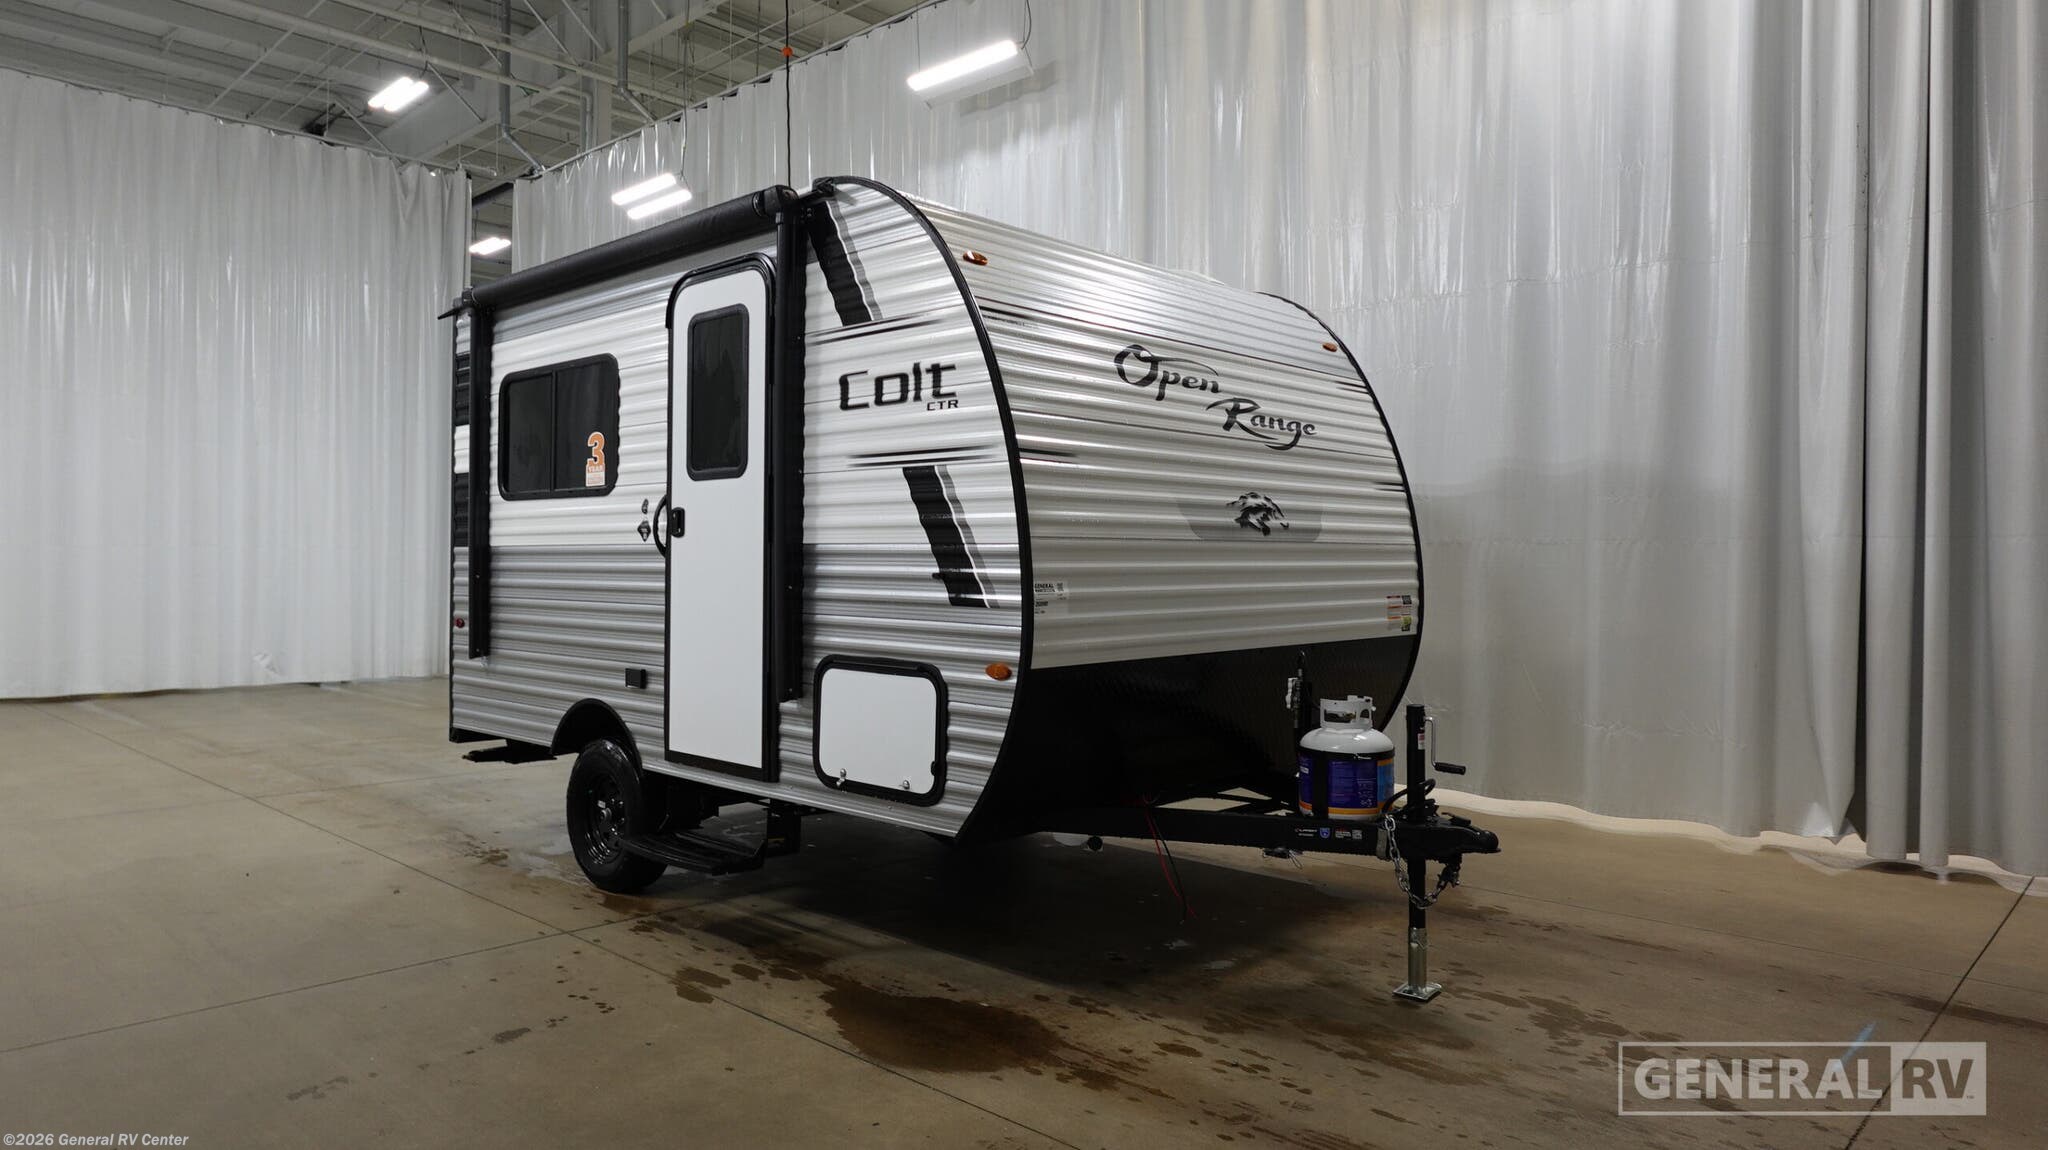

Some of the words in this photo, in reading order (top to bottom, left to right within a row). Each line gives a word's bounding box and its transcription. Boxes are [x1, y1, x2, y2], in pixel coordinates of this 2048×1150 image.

[839, 361, 957, 411] Colt
[926, 399, 959, 411] CTR
[1114, 344, 1222, 401] Open
[1205, 397, 1317, 450] Range
[587, 431, 605, 467] 3
